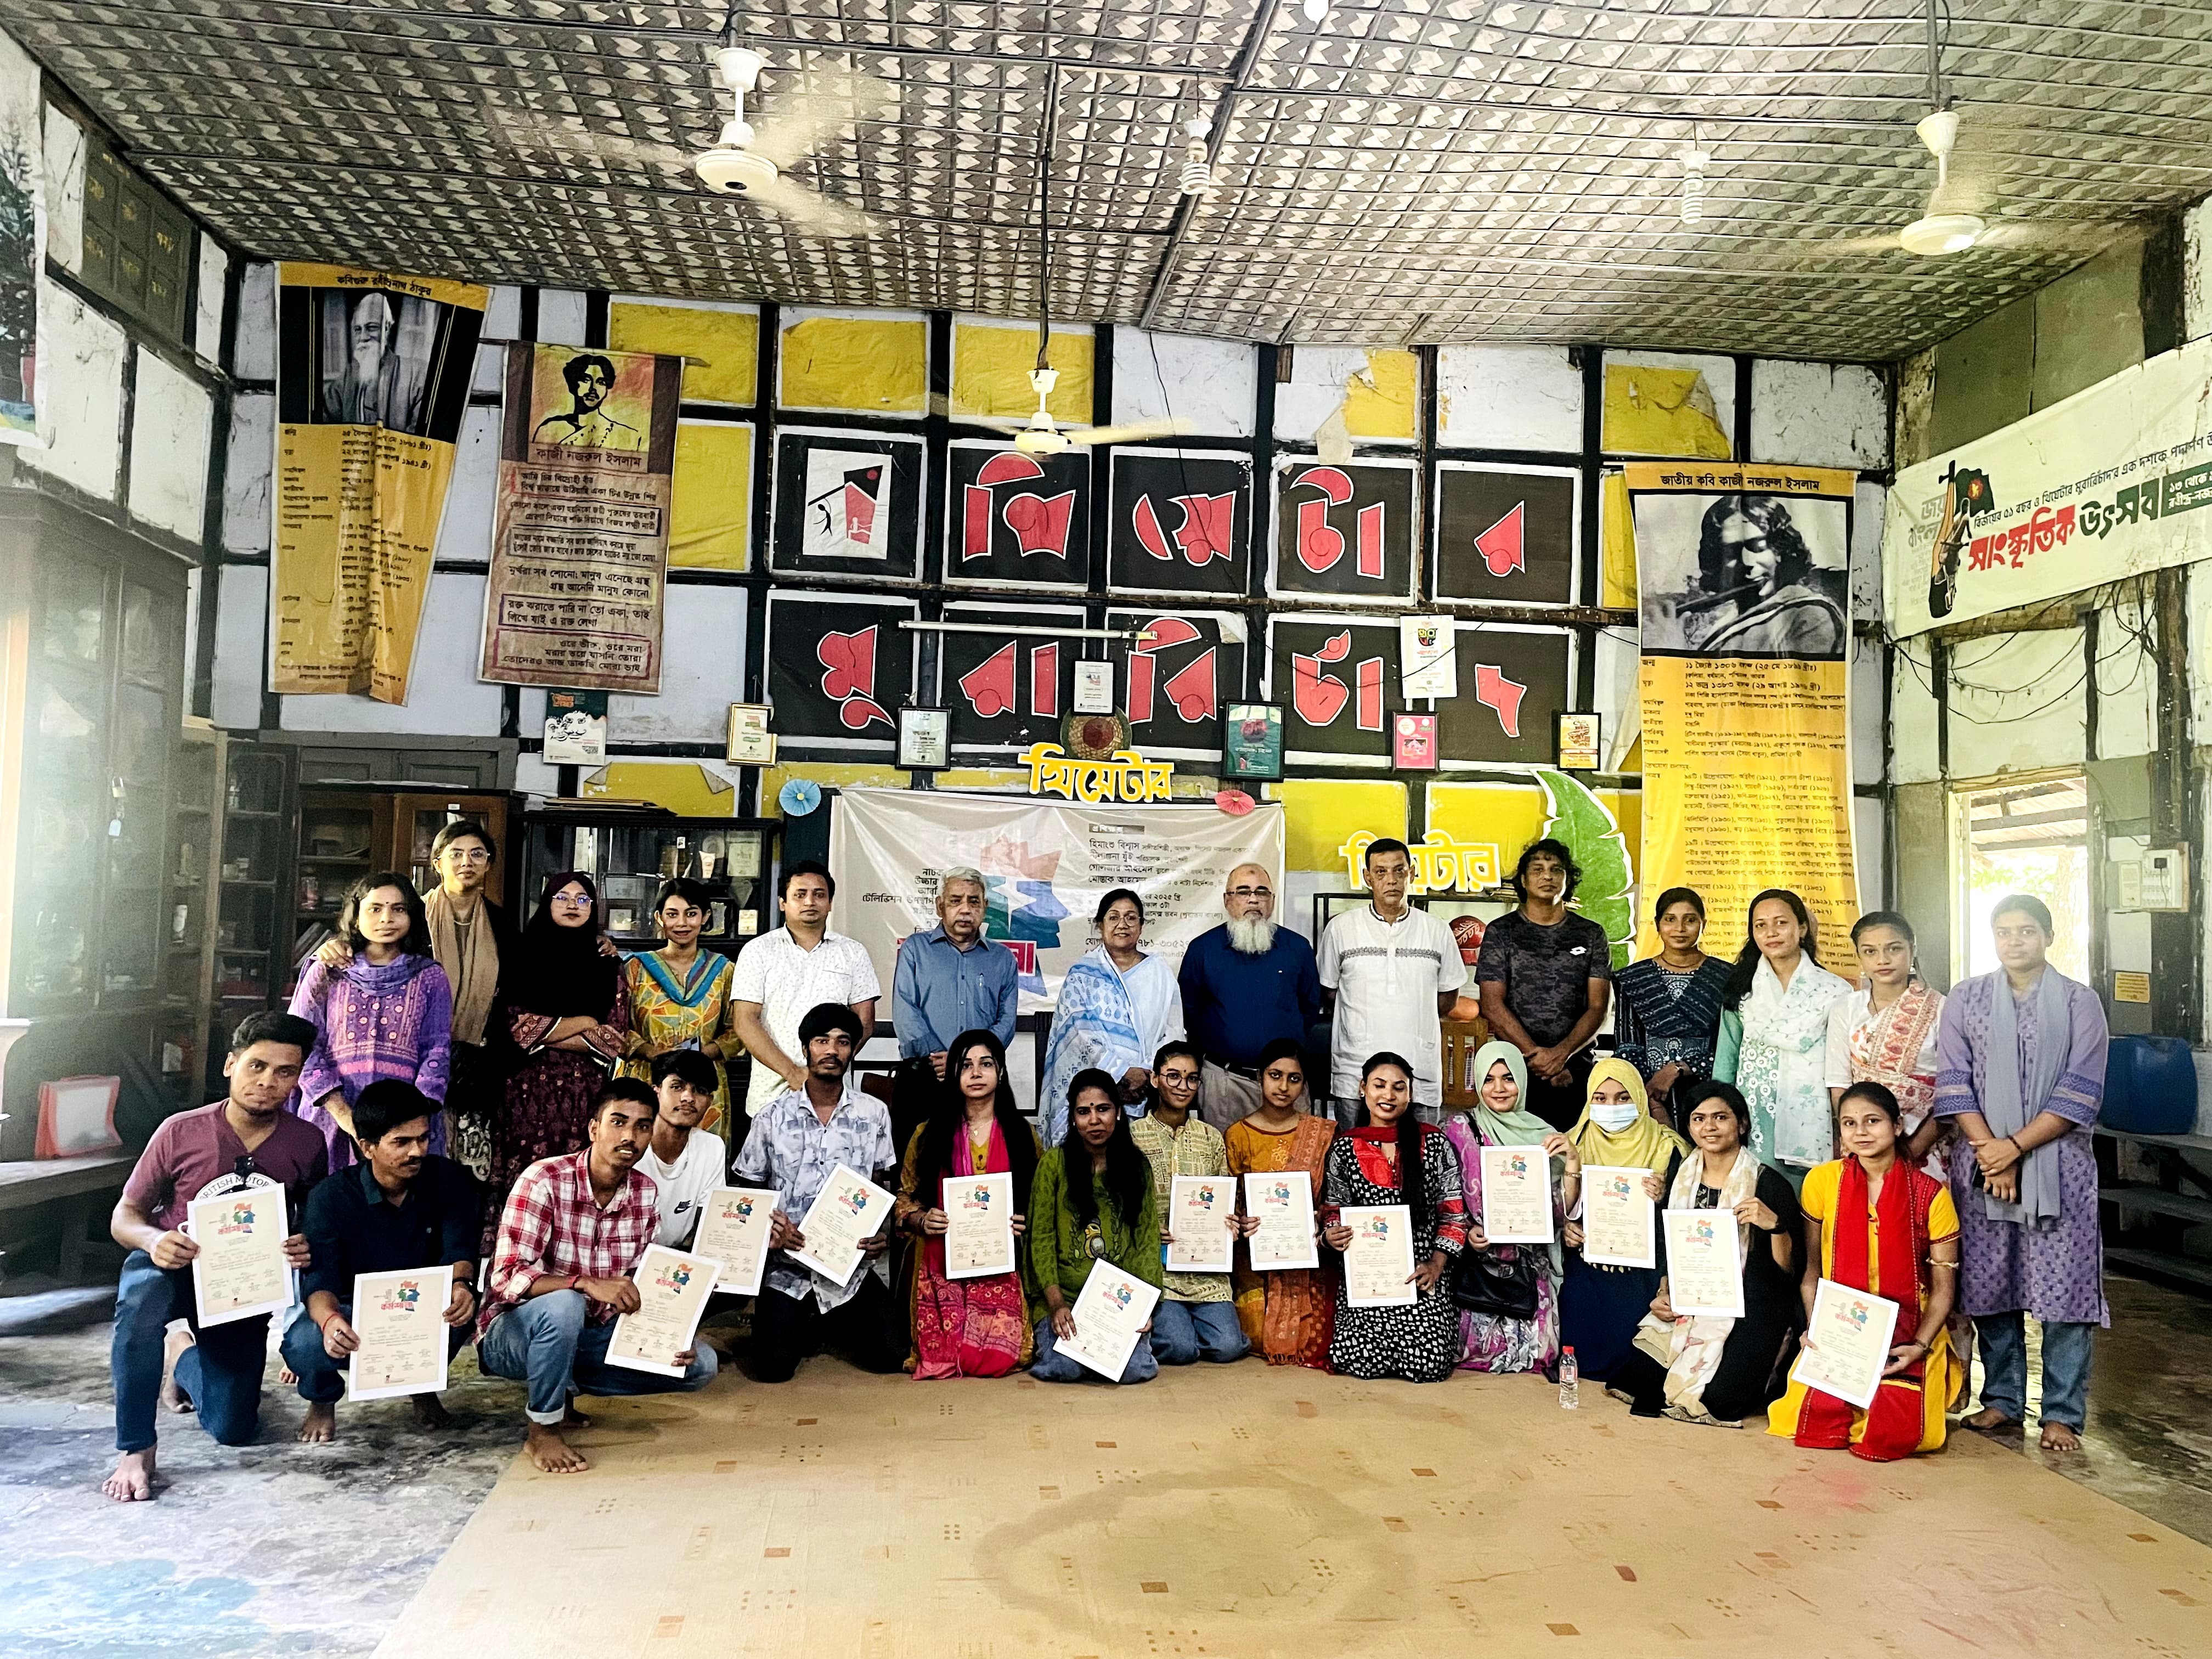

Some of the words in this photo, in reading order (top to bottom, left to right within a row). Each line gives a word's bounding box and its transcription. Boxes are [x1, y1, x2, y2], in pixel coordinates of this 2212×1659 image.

[410, 279, 432, 296] ঠাকুর
[537, 447, 562, 460] কাজী
[567, 451, 602, 463] নজরুল
[606, 450, 641, 467] ইসলাম
[1661, 473, 1692, 486] জাতীয়
[1697, 473, 1715, 487] কবি
[1719, 472, 1743, 487] কাজী
[1747, 477, 1781, 489] নজরুল
[1786, 476, 1820, 490] ইসলাম
[1974, 510, 2002, 529] বিজয়ের
[2016, 500, 2031, 515] বছর
[2034, 498, 2039, 506] ও
[2042, 484, 2073, 504] থিয়েটার
[2121, 460, 2137, 476] এক
[2140, 450, 2168, 467] দশকে
[2079, 477, 2159, 540] উৎসব
[1968, 503, 2076, 572] সাংস্কৃতিক
[580, 571, 601, 581] মানুষ
[597, 585, 619, 598] মানুষ
[622, 588, 648, 599] কোনো
[532, 614, 546, 626] যাই
[550, 618, 557, 626] এ
[558, 602, 575, 613] পারি
[578, 605, 586, 613] না
[590, 606, 604, 615] তো
[633, 608, 650, 620] তাই
[624, 662, 641, 673] ভাই
[1017, 741, 1176, 806] থিয়েটার
[862, 893, 902, 903] টেলিভিশন
